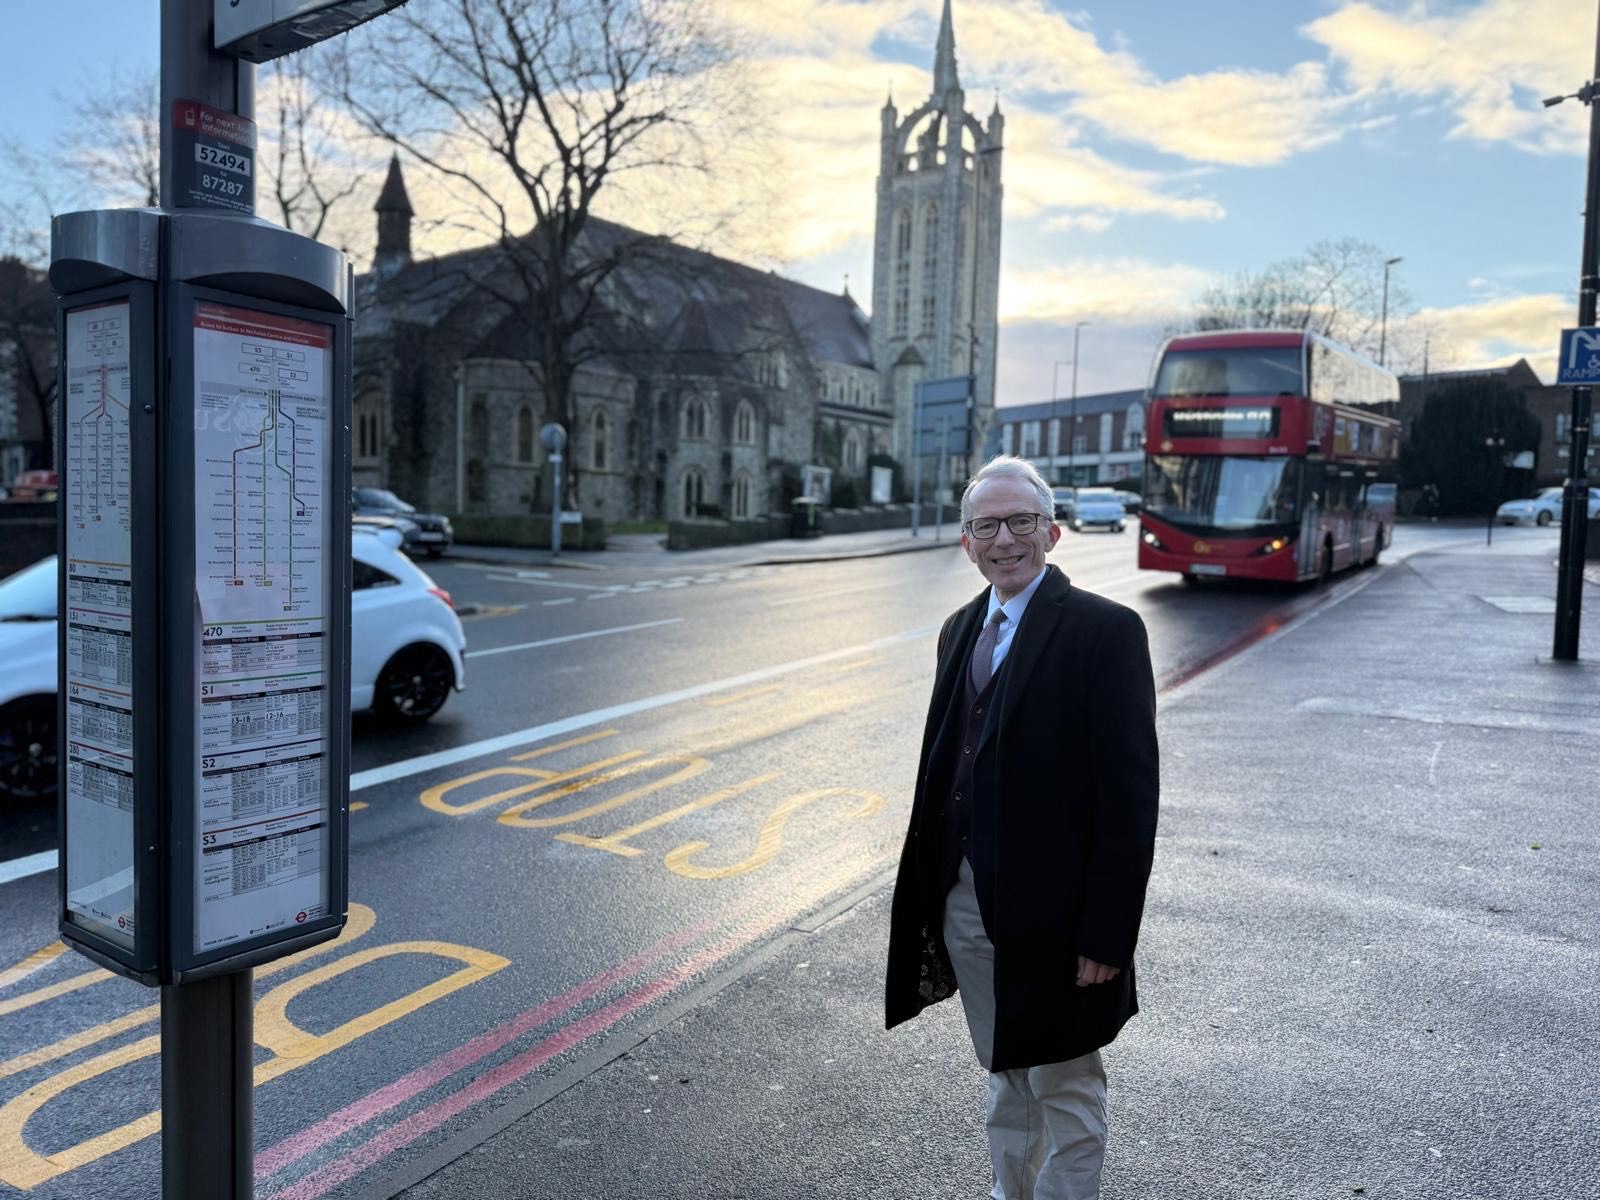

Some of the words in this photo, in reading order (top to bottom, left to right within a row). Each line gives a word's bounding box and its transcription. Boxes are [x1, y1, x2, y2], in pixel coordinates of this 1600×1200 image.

[200, 112, 214, 121] For
[200, 147, 245, 172] 52494
[202, 174, 243, 196] 87287
[1562, 367, 1600, 379] RAMP
[203, 627, 222, 637] 470
[202, 686, 213, 695] S1
[202, 758, 215, 768] S2
[202, 835, 216, 846] S3
